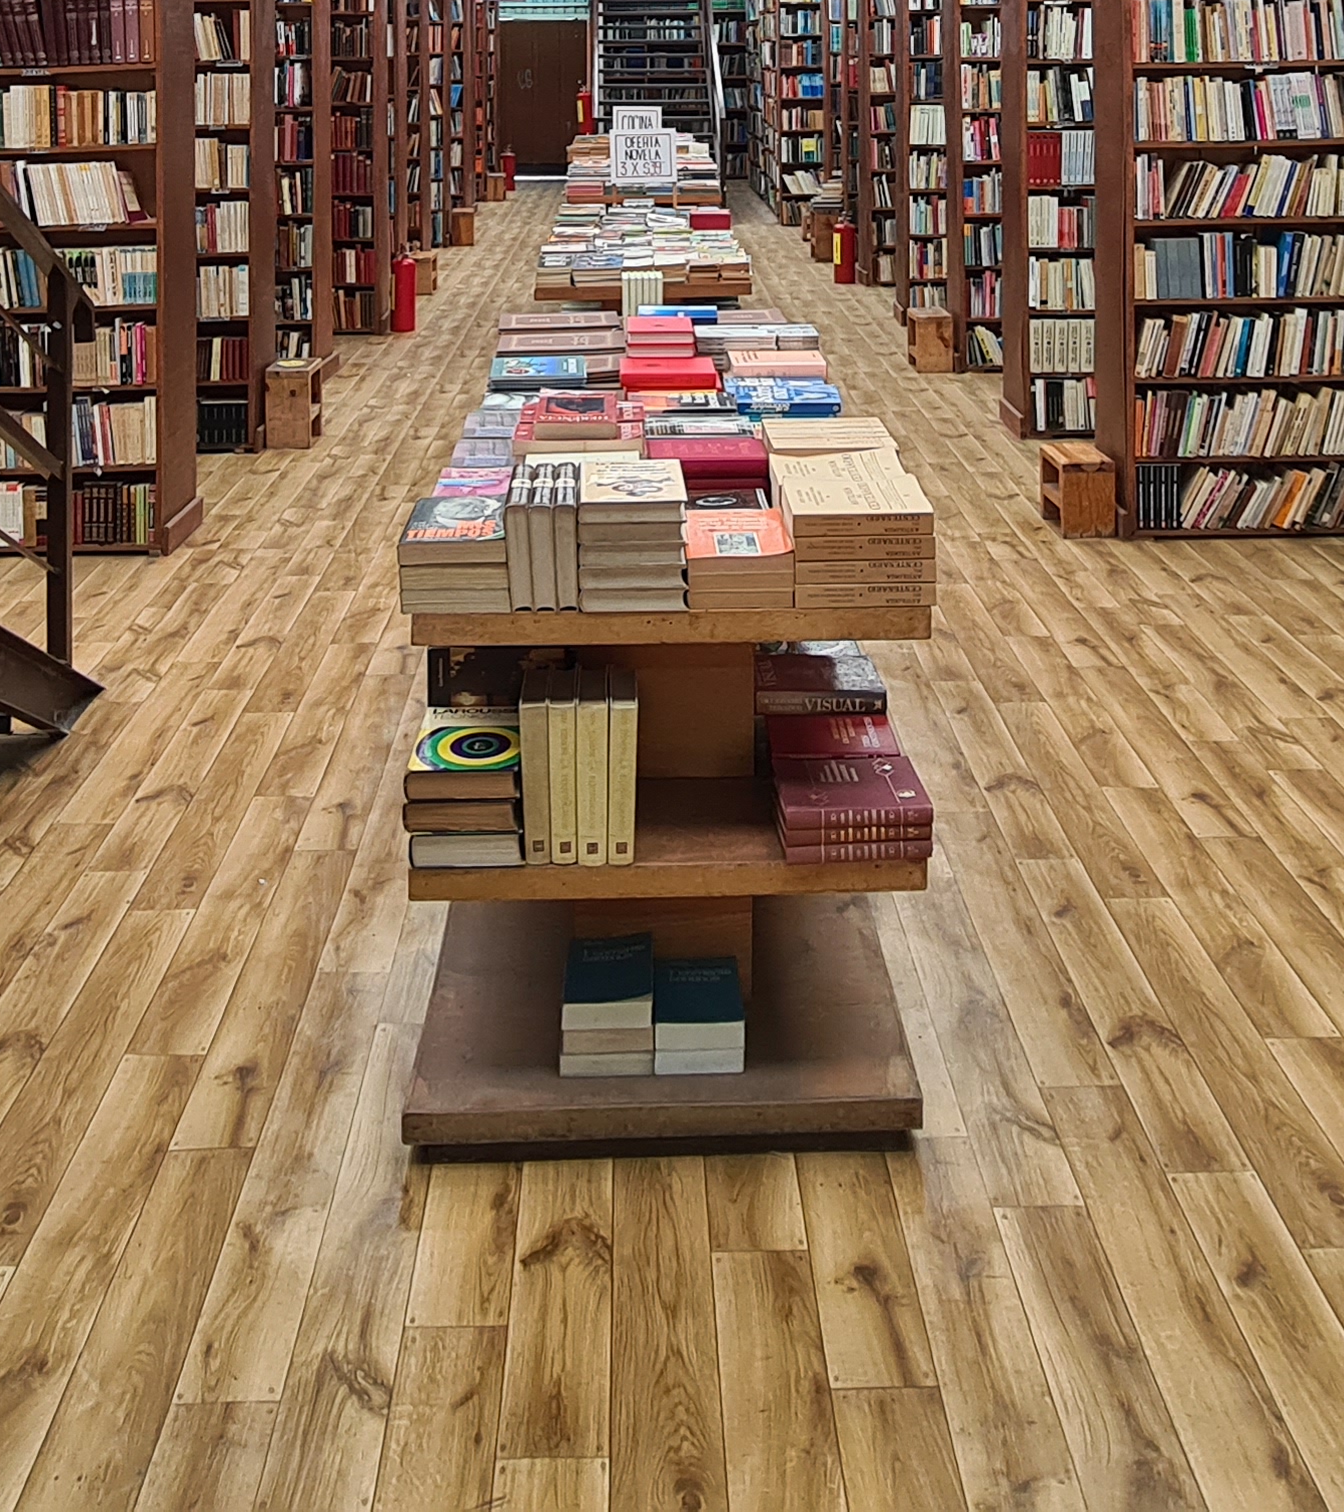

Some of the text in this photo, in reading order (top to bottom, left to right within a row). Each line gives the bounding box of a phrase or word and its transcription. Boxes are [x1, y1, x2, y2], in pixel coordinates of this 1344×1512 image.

[624, 136, 661, 149] OFERTA
[624, 148, 661, 161] NOVELA
[619, 161, 628, 176] 3
[456, 520, 497, 531] MIS
[406, 528, 494, 540] TIEMPOS
[804, 697, 866, 712] VISUAL
